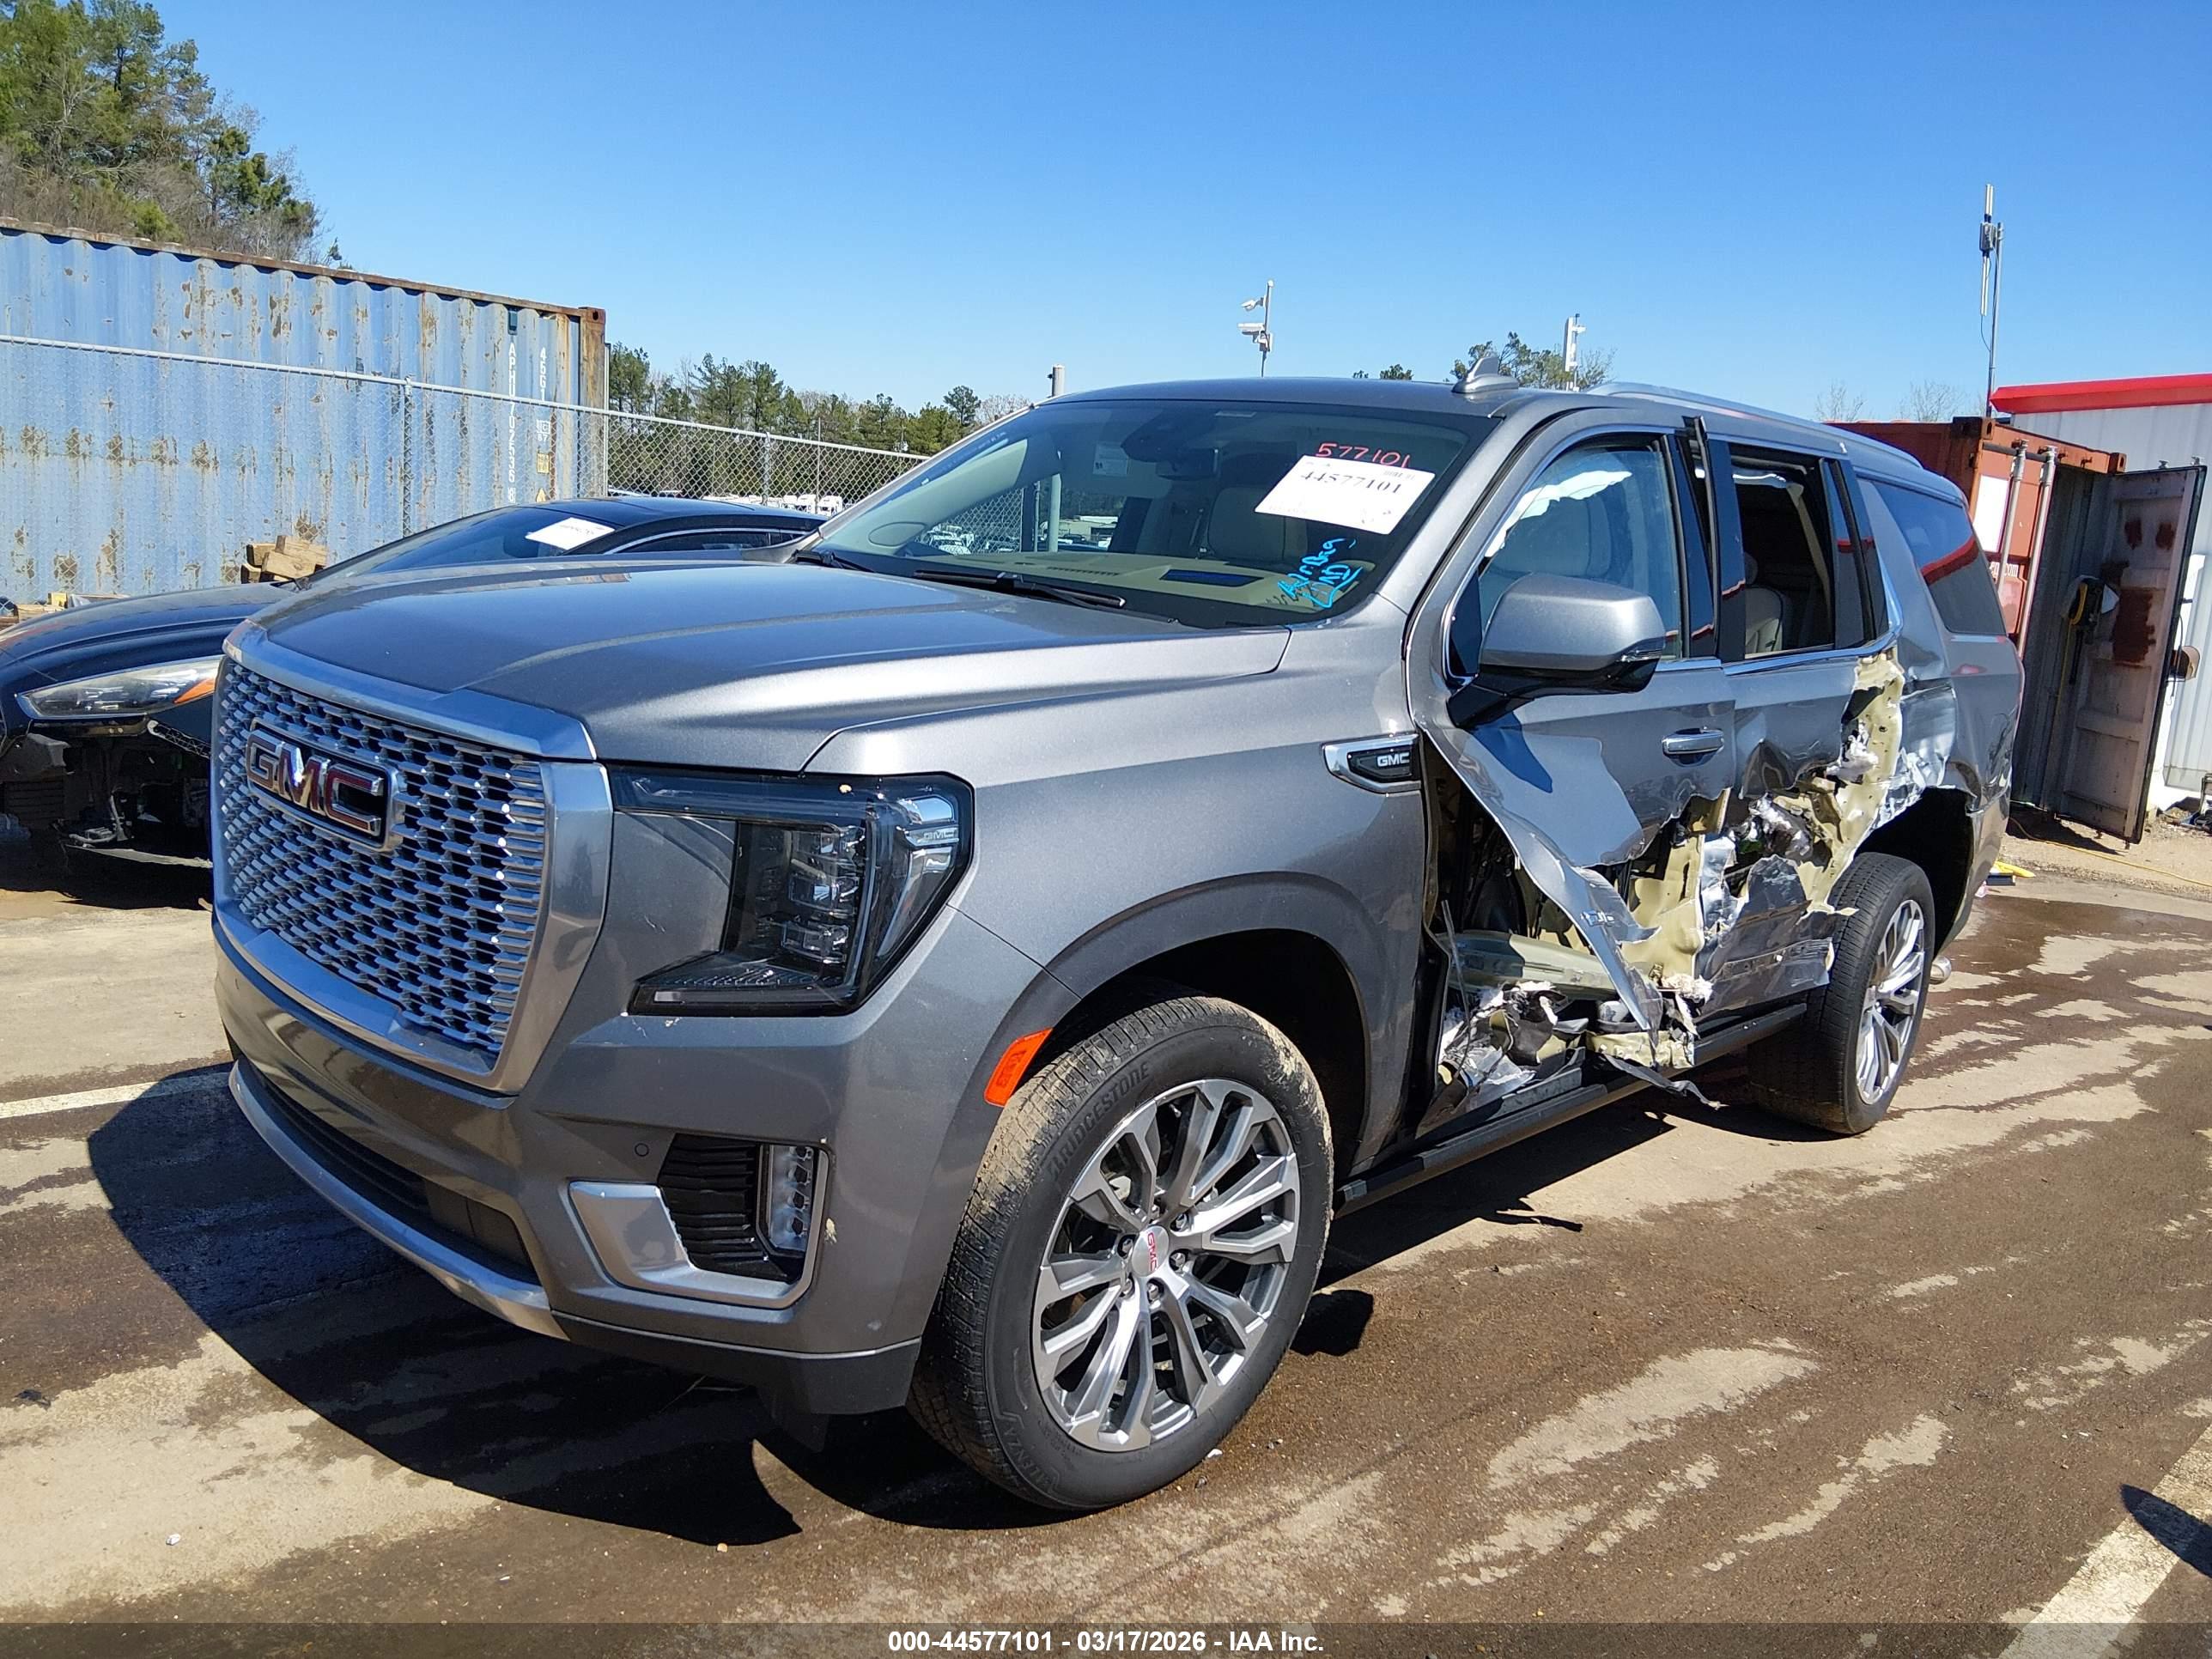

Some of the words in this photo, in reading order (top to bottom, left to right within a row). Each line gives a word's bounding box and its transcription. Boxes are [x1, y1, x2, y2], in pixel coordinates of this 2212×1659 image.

[507, 342, 517, 398] APHU
[1316, 442, 1410, 468] 577101
[1301, 471, 1401, 494] 44577101
[1377, 752, 1410, 767] GMC
[246, 728, 385, 837] GMC
[1048, 1061, 1150, 1178] BRIDGESTONE
[1147, 1231, 1158, 1272] GMC
